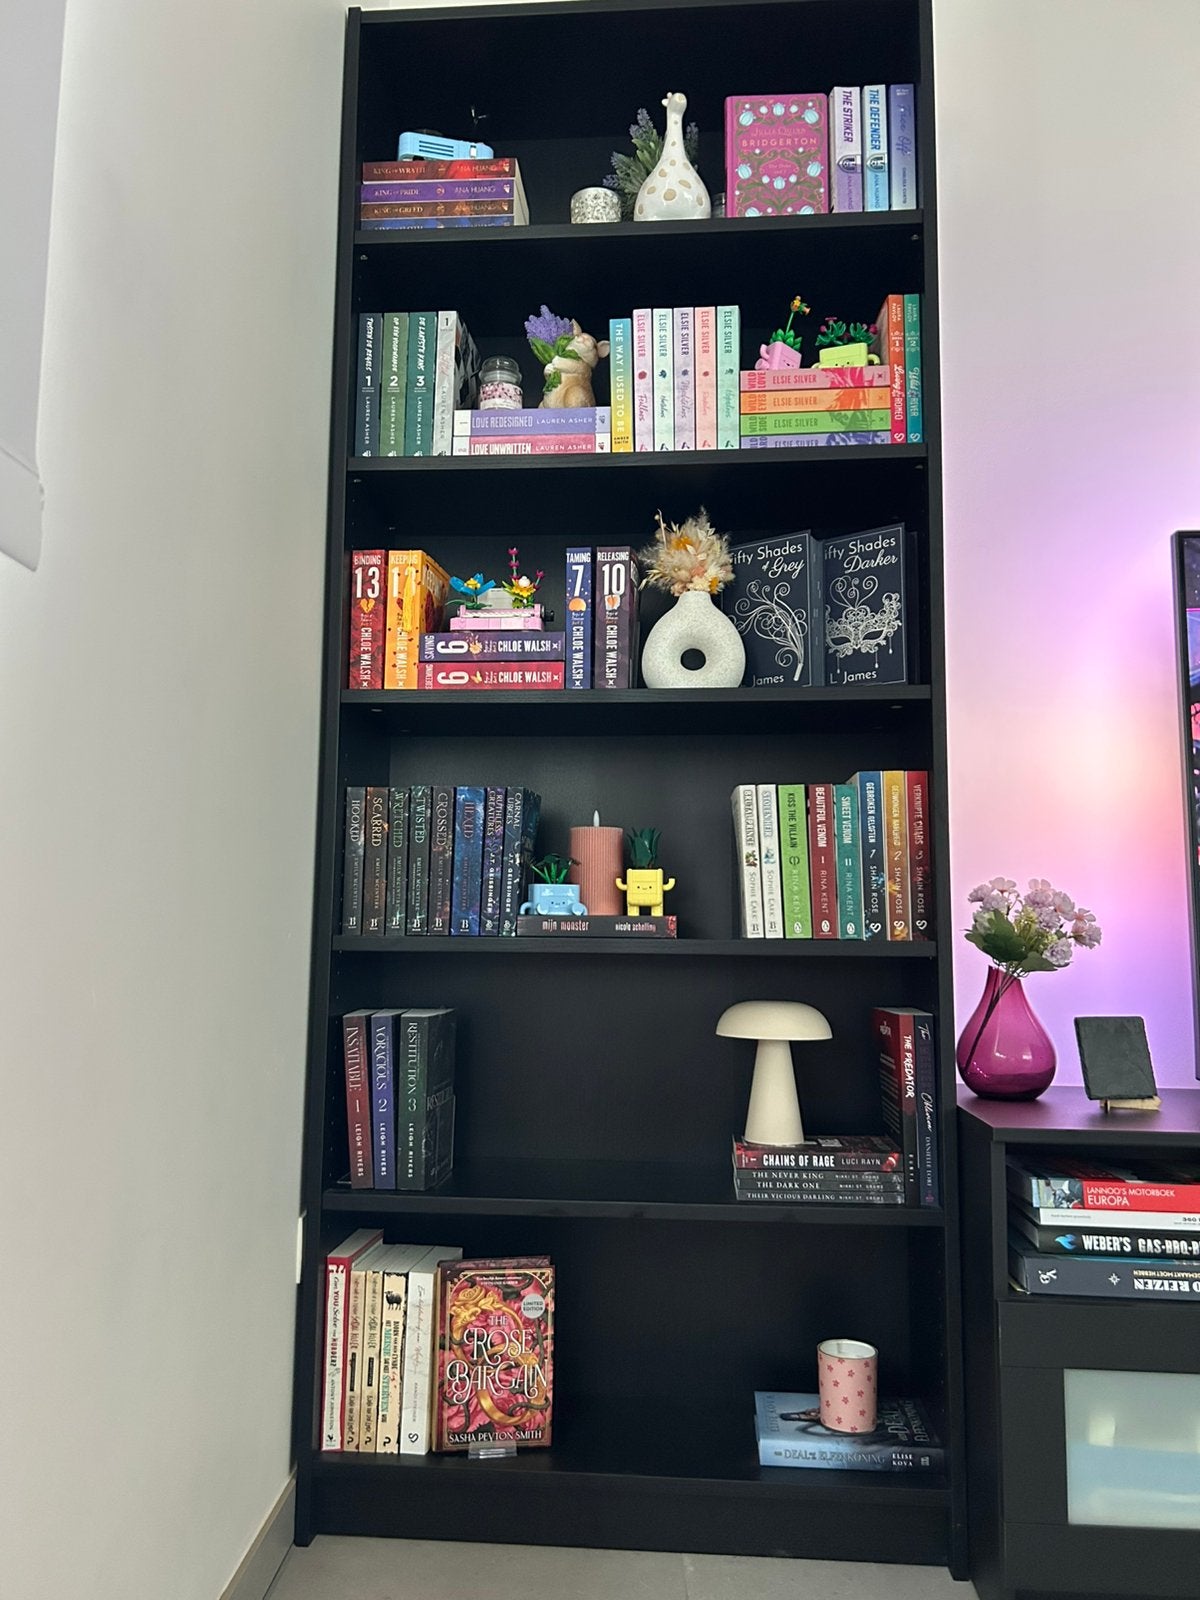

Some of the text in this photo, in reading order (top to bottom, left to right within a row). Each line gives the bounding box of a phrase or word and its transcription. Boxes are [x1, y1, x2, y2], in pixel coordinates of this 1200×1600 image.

[842, 90, 854, 143] THE STRIKER
[869, 89, 881, 150] THE DEFENDER
[742, 137, 817, 147] BRIDGERTON
[471, 185, 496, 193] HUANG
[616, 322, 624, 340] THE
[637, 314, 645, 357] ELSIE SILVER
[681, 312, 689, 356] ELSIE SILVER
[616, 344, 624, 366] WAY
[390, 375, 398, 387] 2
[416, 375, 425, 386] 3
[616, 375, 625, 400] USED
[748, 372, 757, 389] WILD
[757, 371, 767, 389] LOVE
[772, 374, 817, 384] ELSIE SILVER
[617, 404, 625, 417] TO
[748, 393, 757, 411] WILD
[757, 393, 767, 411] EYES
[773, 396, 818, 407] ELSIE SILVER
[895, 397, 903, 420] ROMEO
[472, 415, 533, 429] LOVE REDESIGNED
[536, 416, 593, 425] LAUREN ASHER
[617, 421, 625, 432] BE
[748, 415, 758, 433] WILD
[758, 415, 767, 432] SIDE
[774, 418, 818, 428] ELSIE SILVER
[471, 441, 532, 455] LOVE UNWRITTEN
[535, 442, 593, 452] LAUREN ASHER
[566, 552, 591, 563] TAMING
[597, 551, 629, 561] RELEASING
[730, 541, 803, 565] ifty Shades
[824, 535, 896, 560] ifty Shades
[354, 555, 381, 565] BINDING
[768, 556, 805, 579] Grey
[843, 549, 898, 574] Darker
[355, 566, 380, 598] 13
[571, 564, 584, 597] 7
[602, 563, 625, 596] 10
[360, 627, 372, 651] CHLOE
[424, 635, 435, 660] SAVING
[436, 640, 469, 654] 6
[498, 640, 522, 652] CHLOE
[523, 640, 551, 652] WALSH
[572, 626, 584, 679] CHLOE WALSH
[605, 624, 618, 679] CHLOE WALSH
[359, 653, 372, 680] WALSH
[437, 671, 470, 685] 6
[829, 670, 877, 684] L James
[752, 674, 785, 687] James
[350, 800, 360, 842] HOOKED
[371, 797, 382, 847] SCARRED
[392, 791, 403, 848] WRETCHED
[415, 797, 425, 843] TWISTED
[436, 792, 448, 846] CROSSED
[463, 801, 475, 839] HEXED
[487, 790, 496, 836] CREATURES
[495, 794, 503, 833] RUTHLESS
[506, 797, 514, 825] URGES
[513, 792, 522, 829] CARNAL
[788, 792, 798, 848] KISS THE VILLAIN
[815, 787, 827, 848] BEAUTIFUL VENOM
[842, 796, 852, 844] SWEET VENOM
[866, 782, 876, 843] GEBROKEN GELOFTEN
[913, 784, 923, 845] VERKNIPTE CHAOS
[870, 866, 879, 914] SHAIN ROSE
[894, 867, 903, 914] SHAIN ROSE
[916, 866, 925, 914] SHAIN ROSE
[793, 895, 801, 918] KENT
[542, 919, 590, 932] mijn monster
[374, 1026, 387, 1091] VORACIOUS
[407, 1022, 418, 1095] RESTITUTION
[903, 1035, 914, 1098] THE PREDATOR
[378, 1099, 387, 1112] 2
[408, 1099, 417, 1112] 3
[356, 1150, 364, 1177] RIVERS
[762, 1154, 835, 1167] CHAINS OF RAGE
[861, 1158, 881, 1166] RAYN
[1086, 1186, 1175, 1198] LANNOO'S MOTORBOEK
[1087, 1195, 1130, 1207] EUROPA
[1081, 1234, 1131, 1252] WEBER'S
[1134, 1278, 1190, 1292] REIZEN
[488, 1315, 507, 1326] THE
[463, 1327, 534, 1367] ROSE
[446, 1358, 549, 1405] BARGAIN
[449, 1429, 542, 1444] SASHA PEYTON SMITH
[784, 1449, 809, 1460] DEAL
